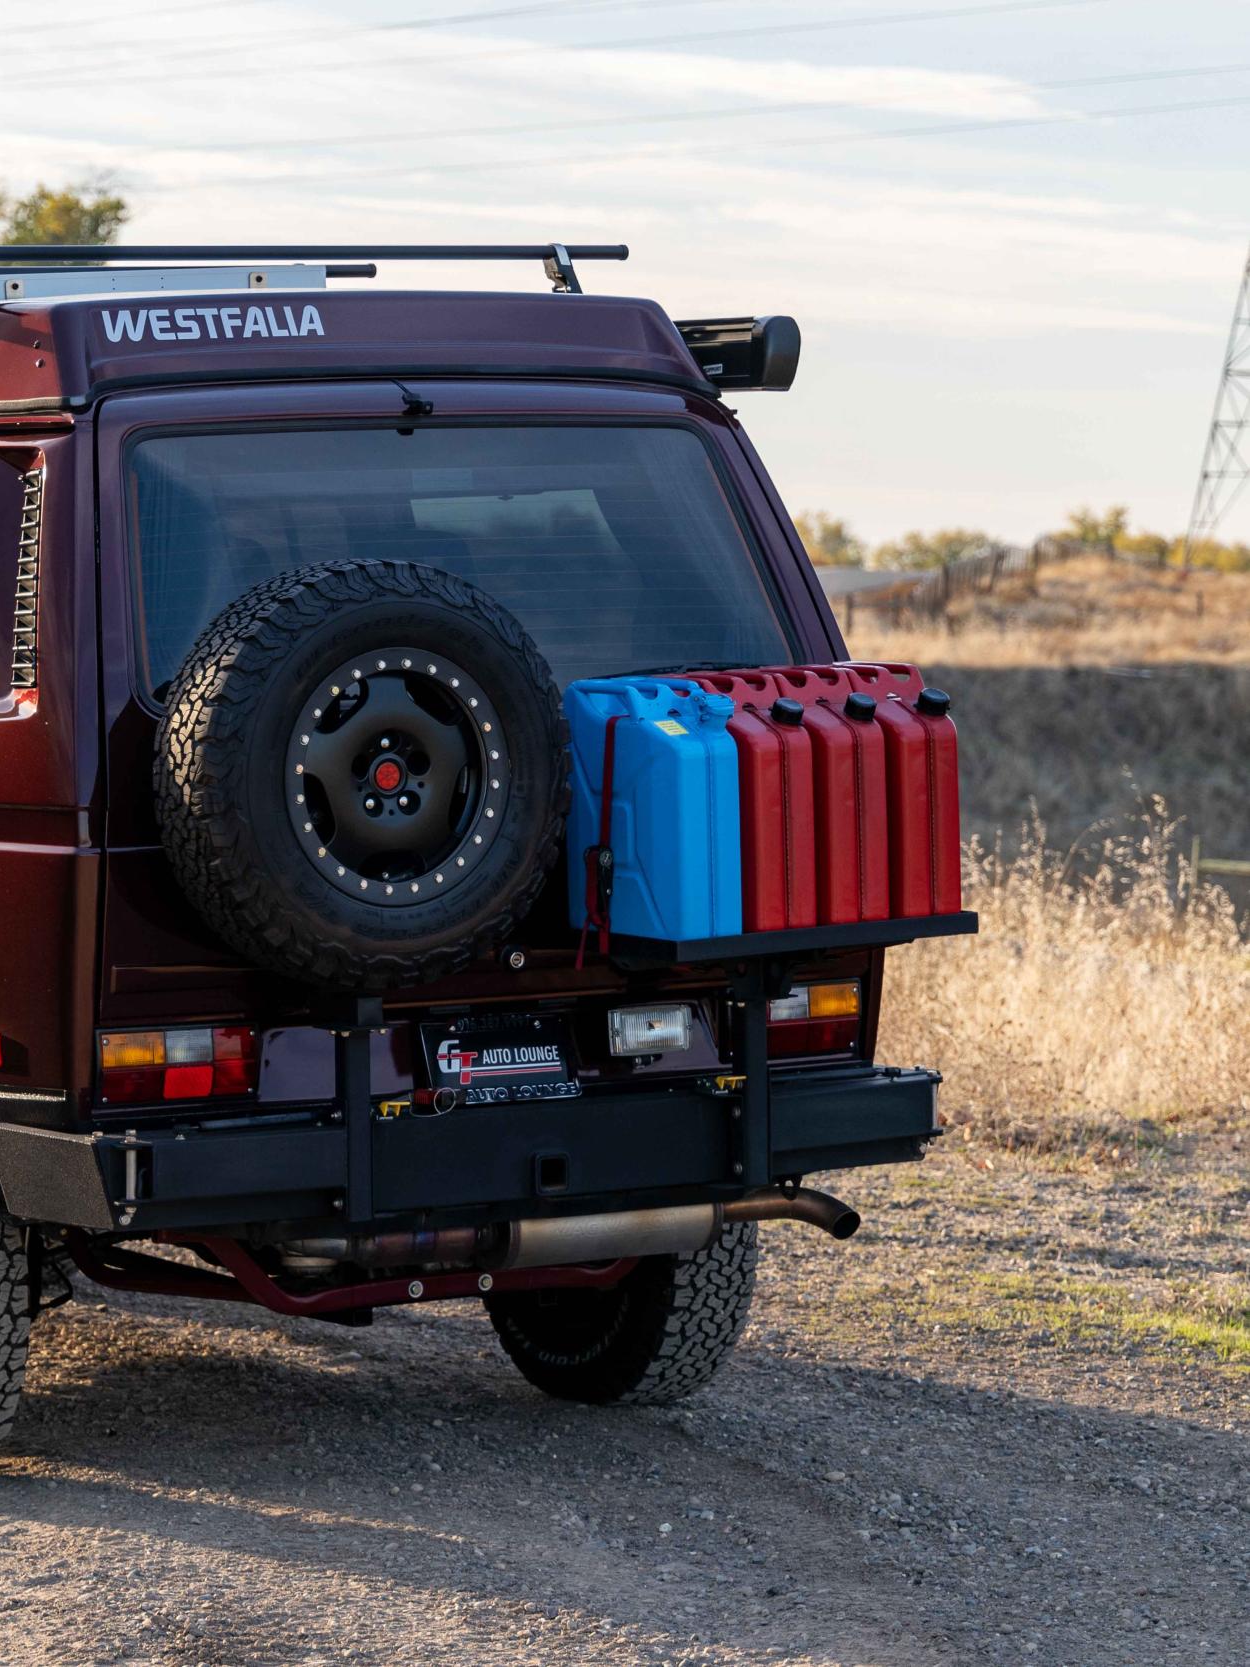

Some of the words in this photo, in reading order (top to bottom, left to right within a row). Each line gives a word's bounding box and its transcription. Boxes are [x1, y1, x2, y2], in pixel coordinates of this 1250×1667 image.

[101, 305, 325, 343] WESTFALIA
[437, 1039, 478, 1084] GT
[483, 1048, 511, 1065] AUTO
[516, 1045, 560, 1063] LOUNGE
[466, 1087, 509, 1103] AUTO
[512, 1082, 577, 1098] LOUNGE
